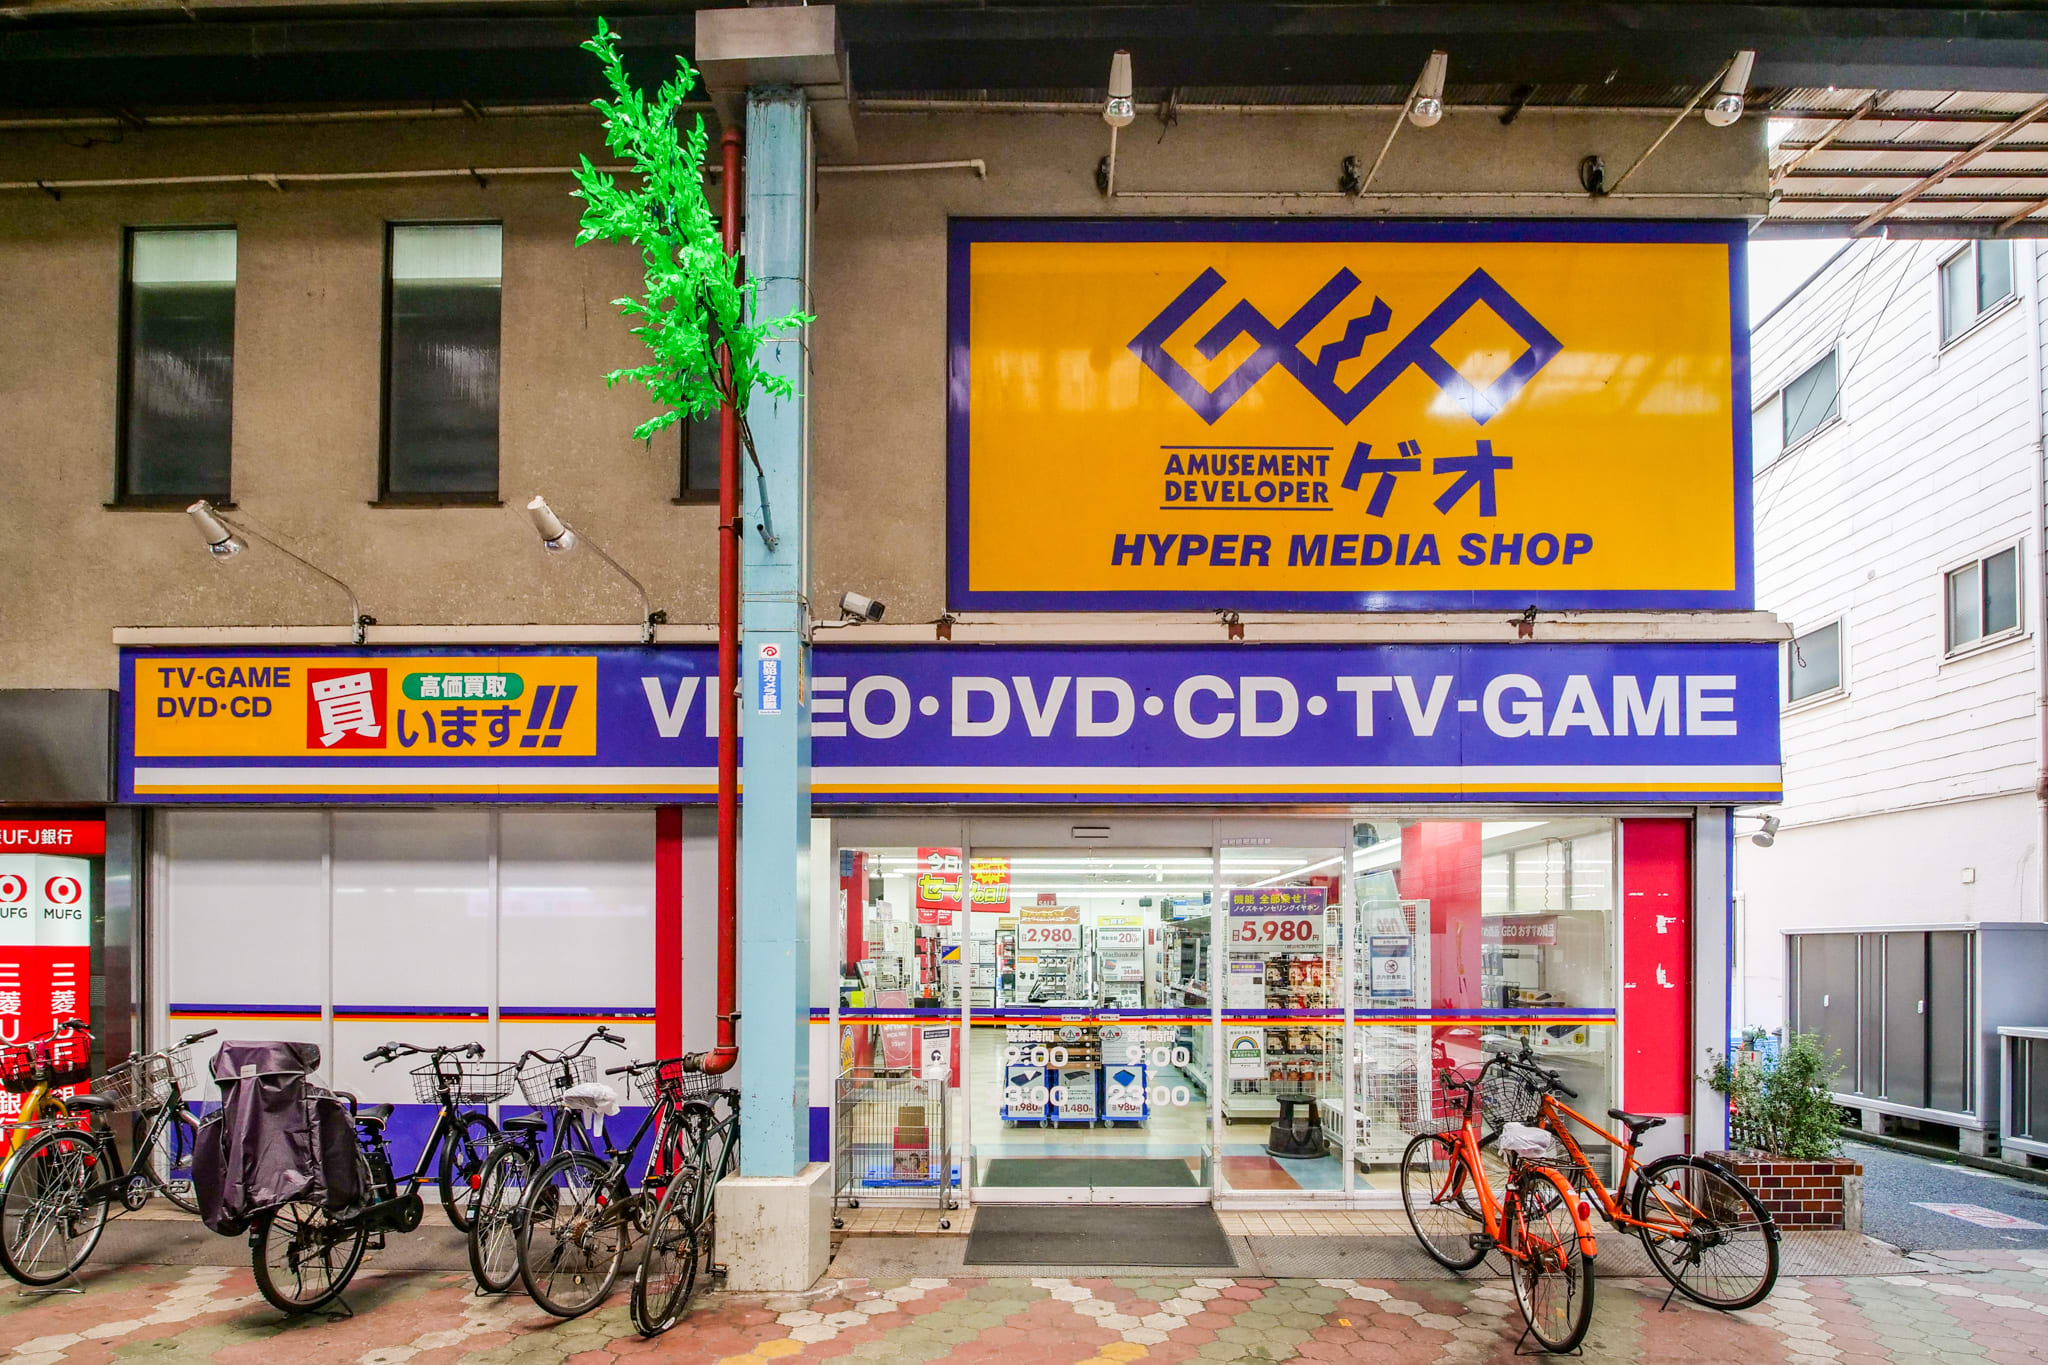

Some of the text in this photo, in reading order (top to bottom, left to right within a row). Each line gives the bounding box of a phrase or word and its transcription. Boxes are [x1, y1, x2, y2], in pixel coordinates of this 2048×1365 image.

[1164, 454, 1330, 477] AMUSEMENT
[1341, 439, 1513, 518] ゲオ
[1164, 480, 1329, 503] DEVELOPER
[1111, 532, 1594, 567] HYPER MEDIA SHOP
[157, 667, 291, 689] TV-GAME
[419, 675, 508, 698] 高価買取
[43, 909, 82, 920] MUFG
[1004, 1046, 1069, 1067] 9:00
[1125, 1045, 1190, 1067] 9:00
